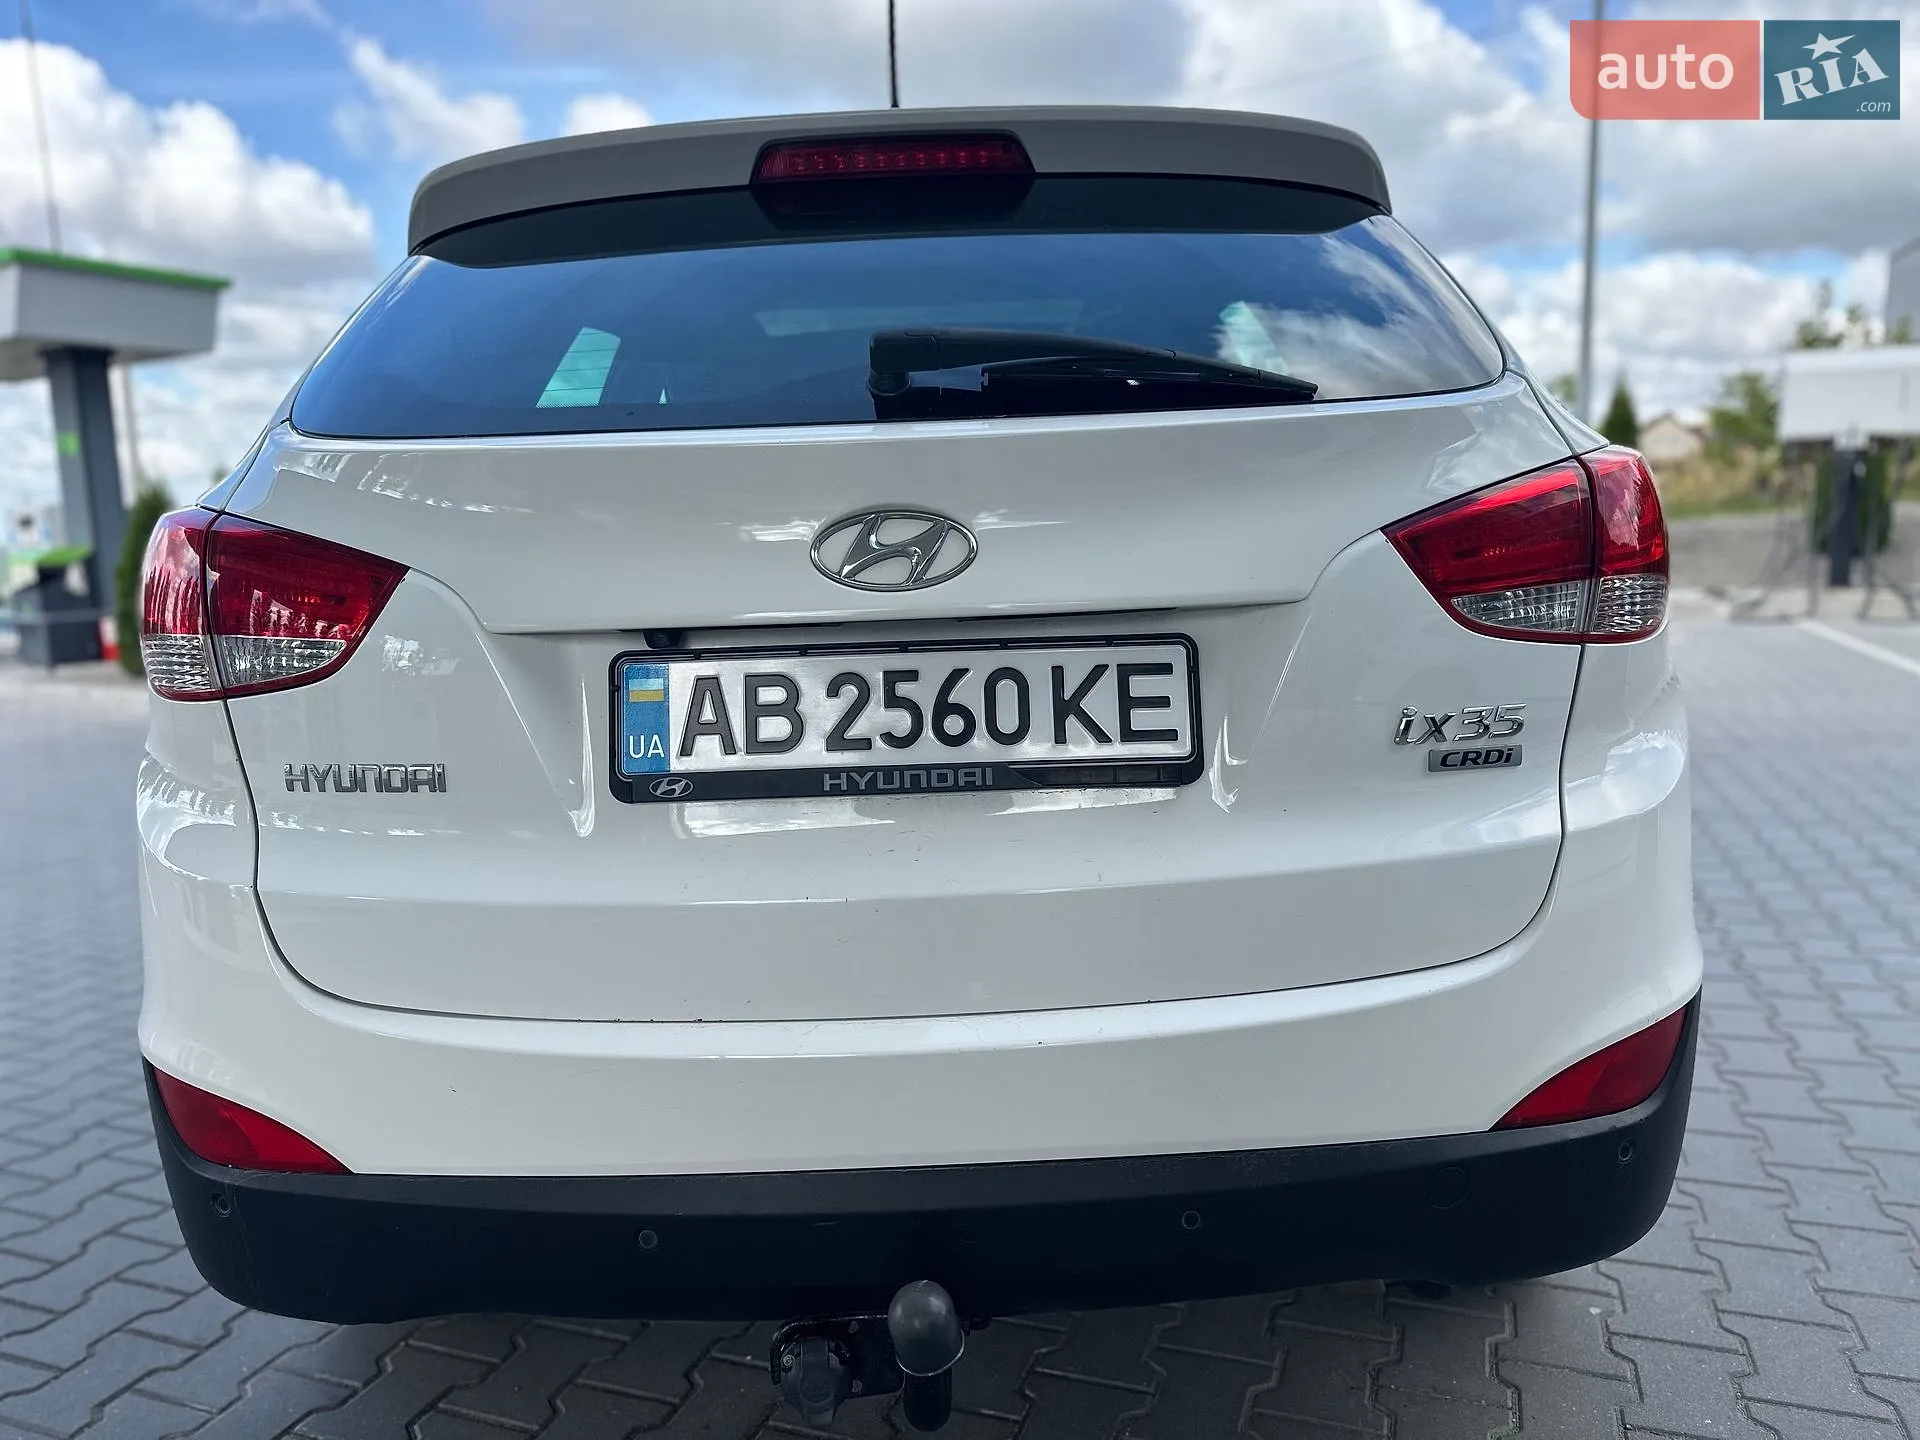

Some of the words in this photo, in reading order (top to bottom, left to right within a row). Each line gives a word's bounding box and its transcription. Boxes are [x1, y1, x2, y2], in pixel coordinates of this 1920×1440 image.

[678, 673, 804, 757] AB
[823, 666, 1031, 752] 2560
[1051, 662, 1179, 745] KE
[1394, 703, 1527, 746] ix35
[629, 735, 665, 759] UA
[1440, 747, 1514, 768] CRDi
[283, 763, 447, 793] HYUNDAI
[823, 766, 993, 793] HYUNDAI
